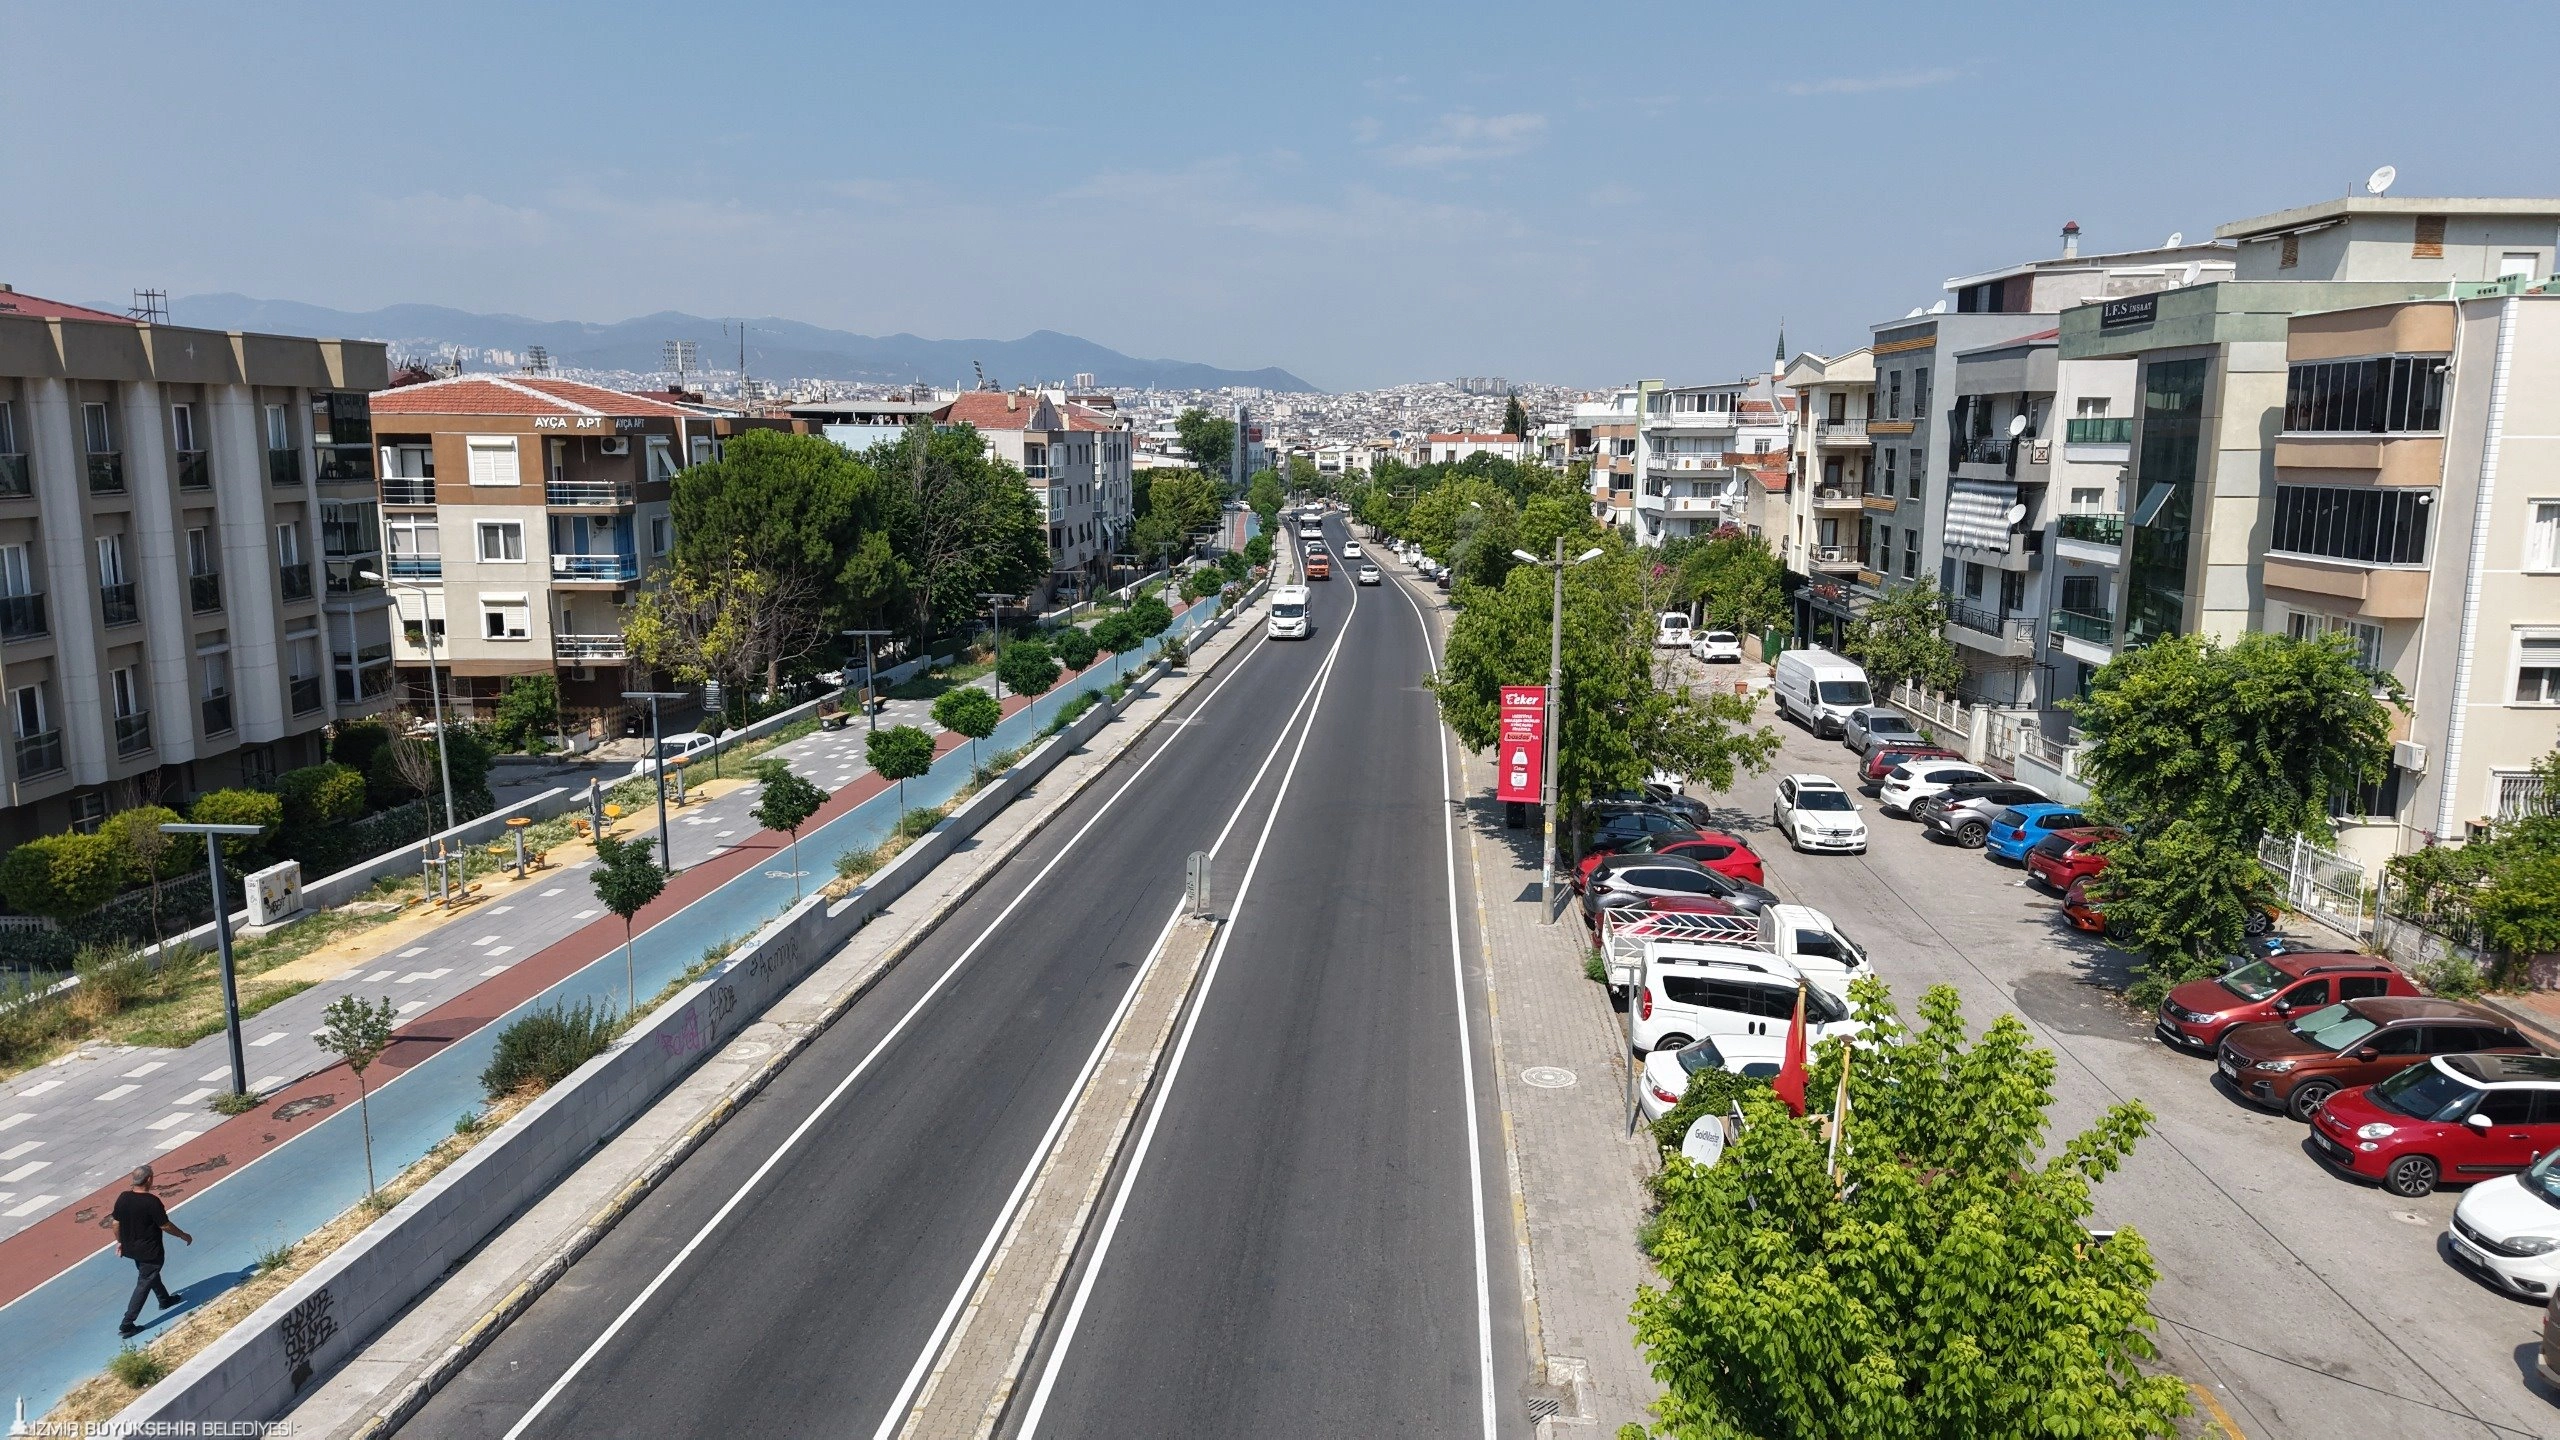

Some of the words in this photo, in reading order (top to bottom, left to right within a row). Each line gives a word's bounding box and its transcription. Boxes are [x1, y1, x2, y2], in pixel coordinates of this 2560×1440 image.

[535, 417, 567, 429] AYÇA
[577, 418, 601, 428] APT
[616, 418, 633, 430] AYÇA
[634, 418, 645, 428] APT
